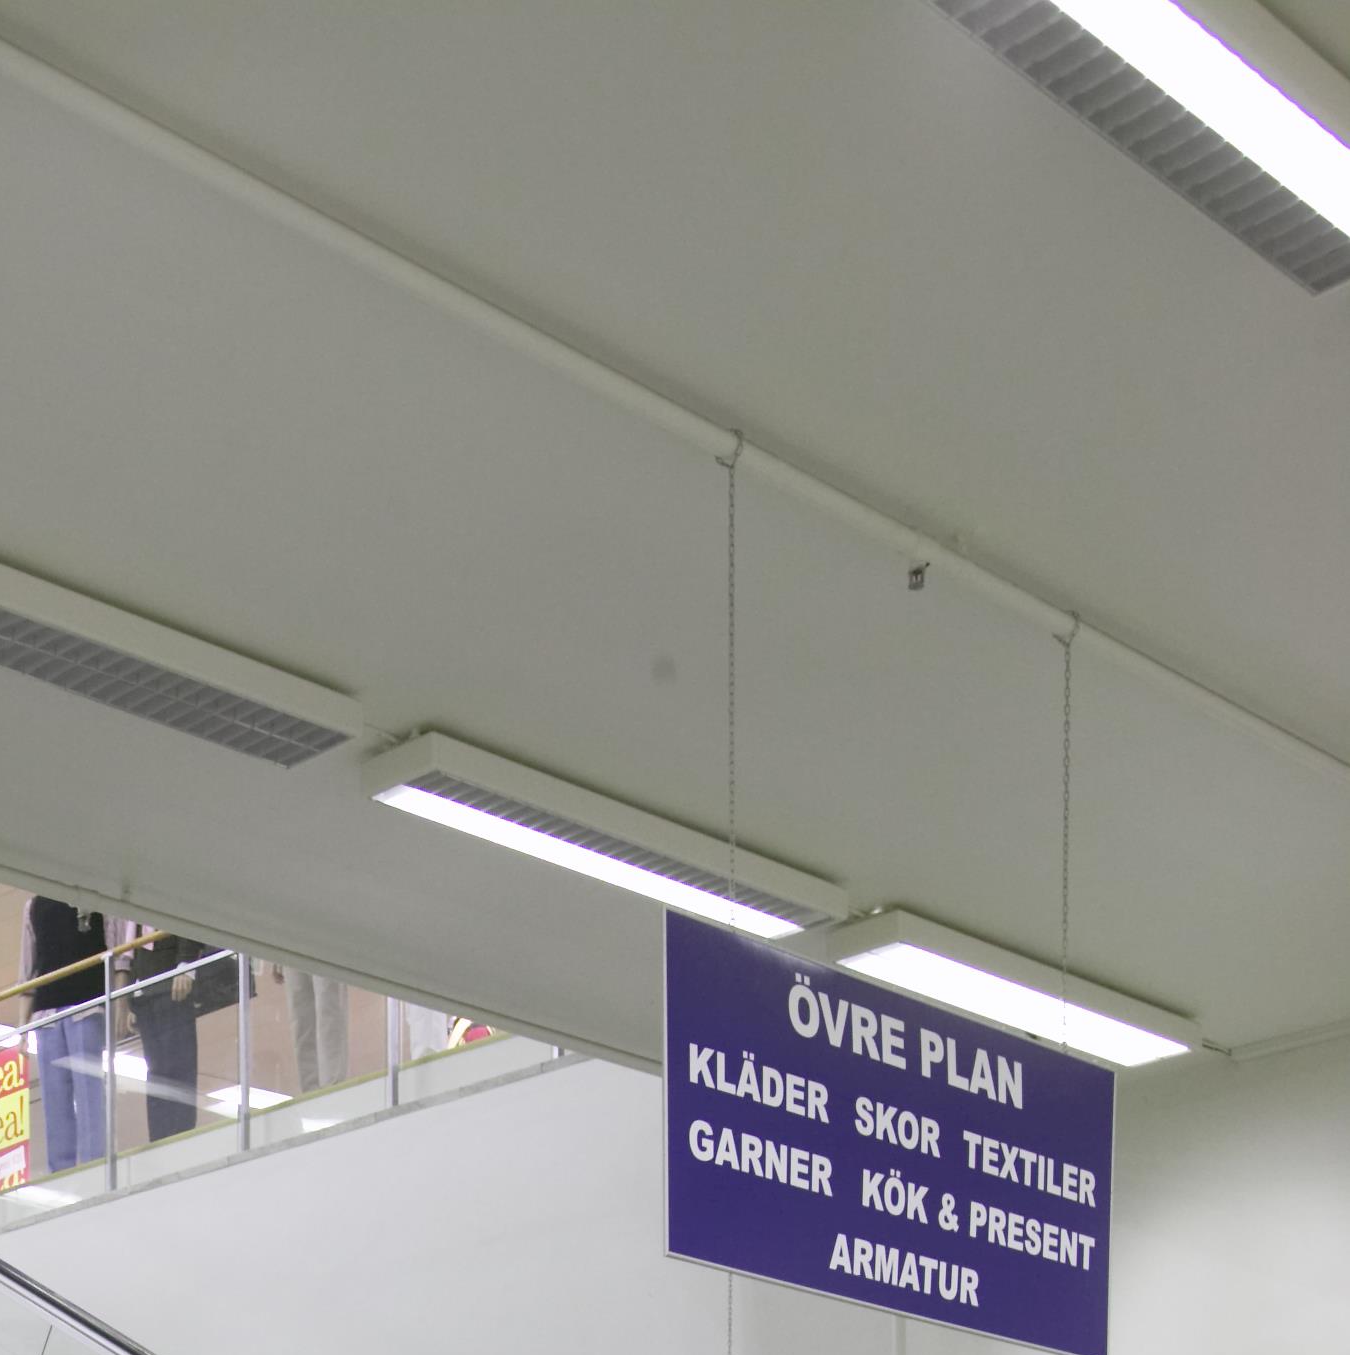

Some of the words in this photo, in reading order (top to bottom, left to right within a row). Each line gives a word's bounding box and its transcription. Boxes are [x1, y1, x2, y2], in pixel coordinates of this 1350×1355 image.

[787, 972, 907, 1070] ÖVRE
[920, 1027, 1024, 1110] PLAN
[688, 1119, 833, 1197] GARNER
[861, 1168, 929, 1224] KÖK
[937, 1193, 960, 1233] &
[968, 1200, 1096, 1271] PRESENT
[689, 1042, 830, 1124] KLÄDER
[854, 1096, 941, 1158] SKOR
[962, 1129, 1096, 1208] TEXTILER
[829, 1233, 980, 1307] ARMATUR
